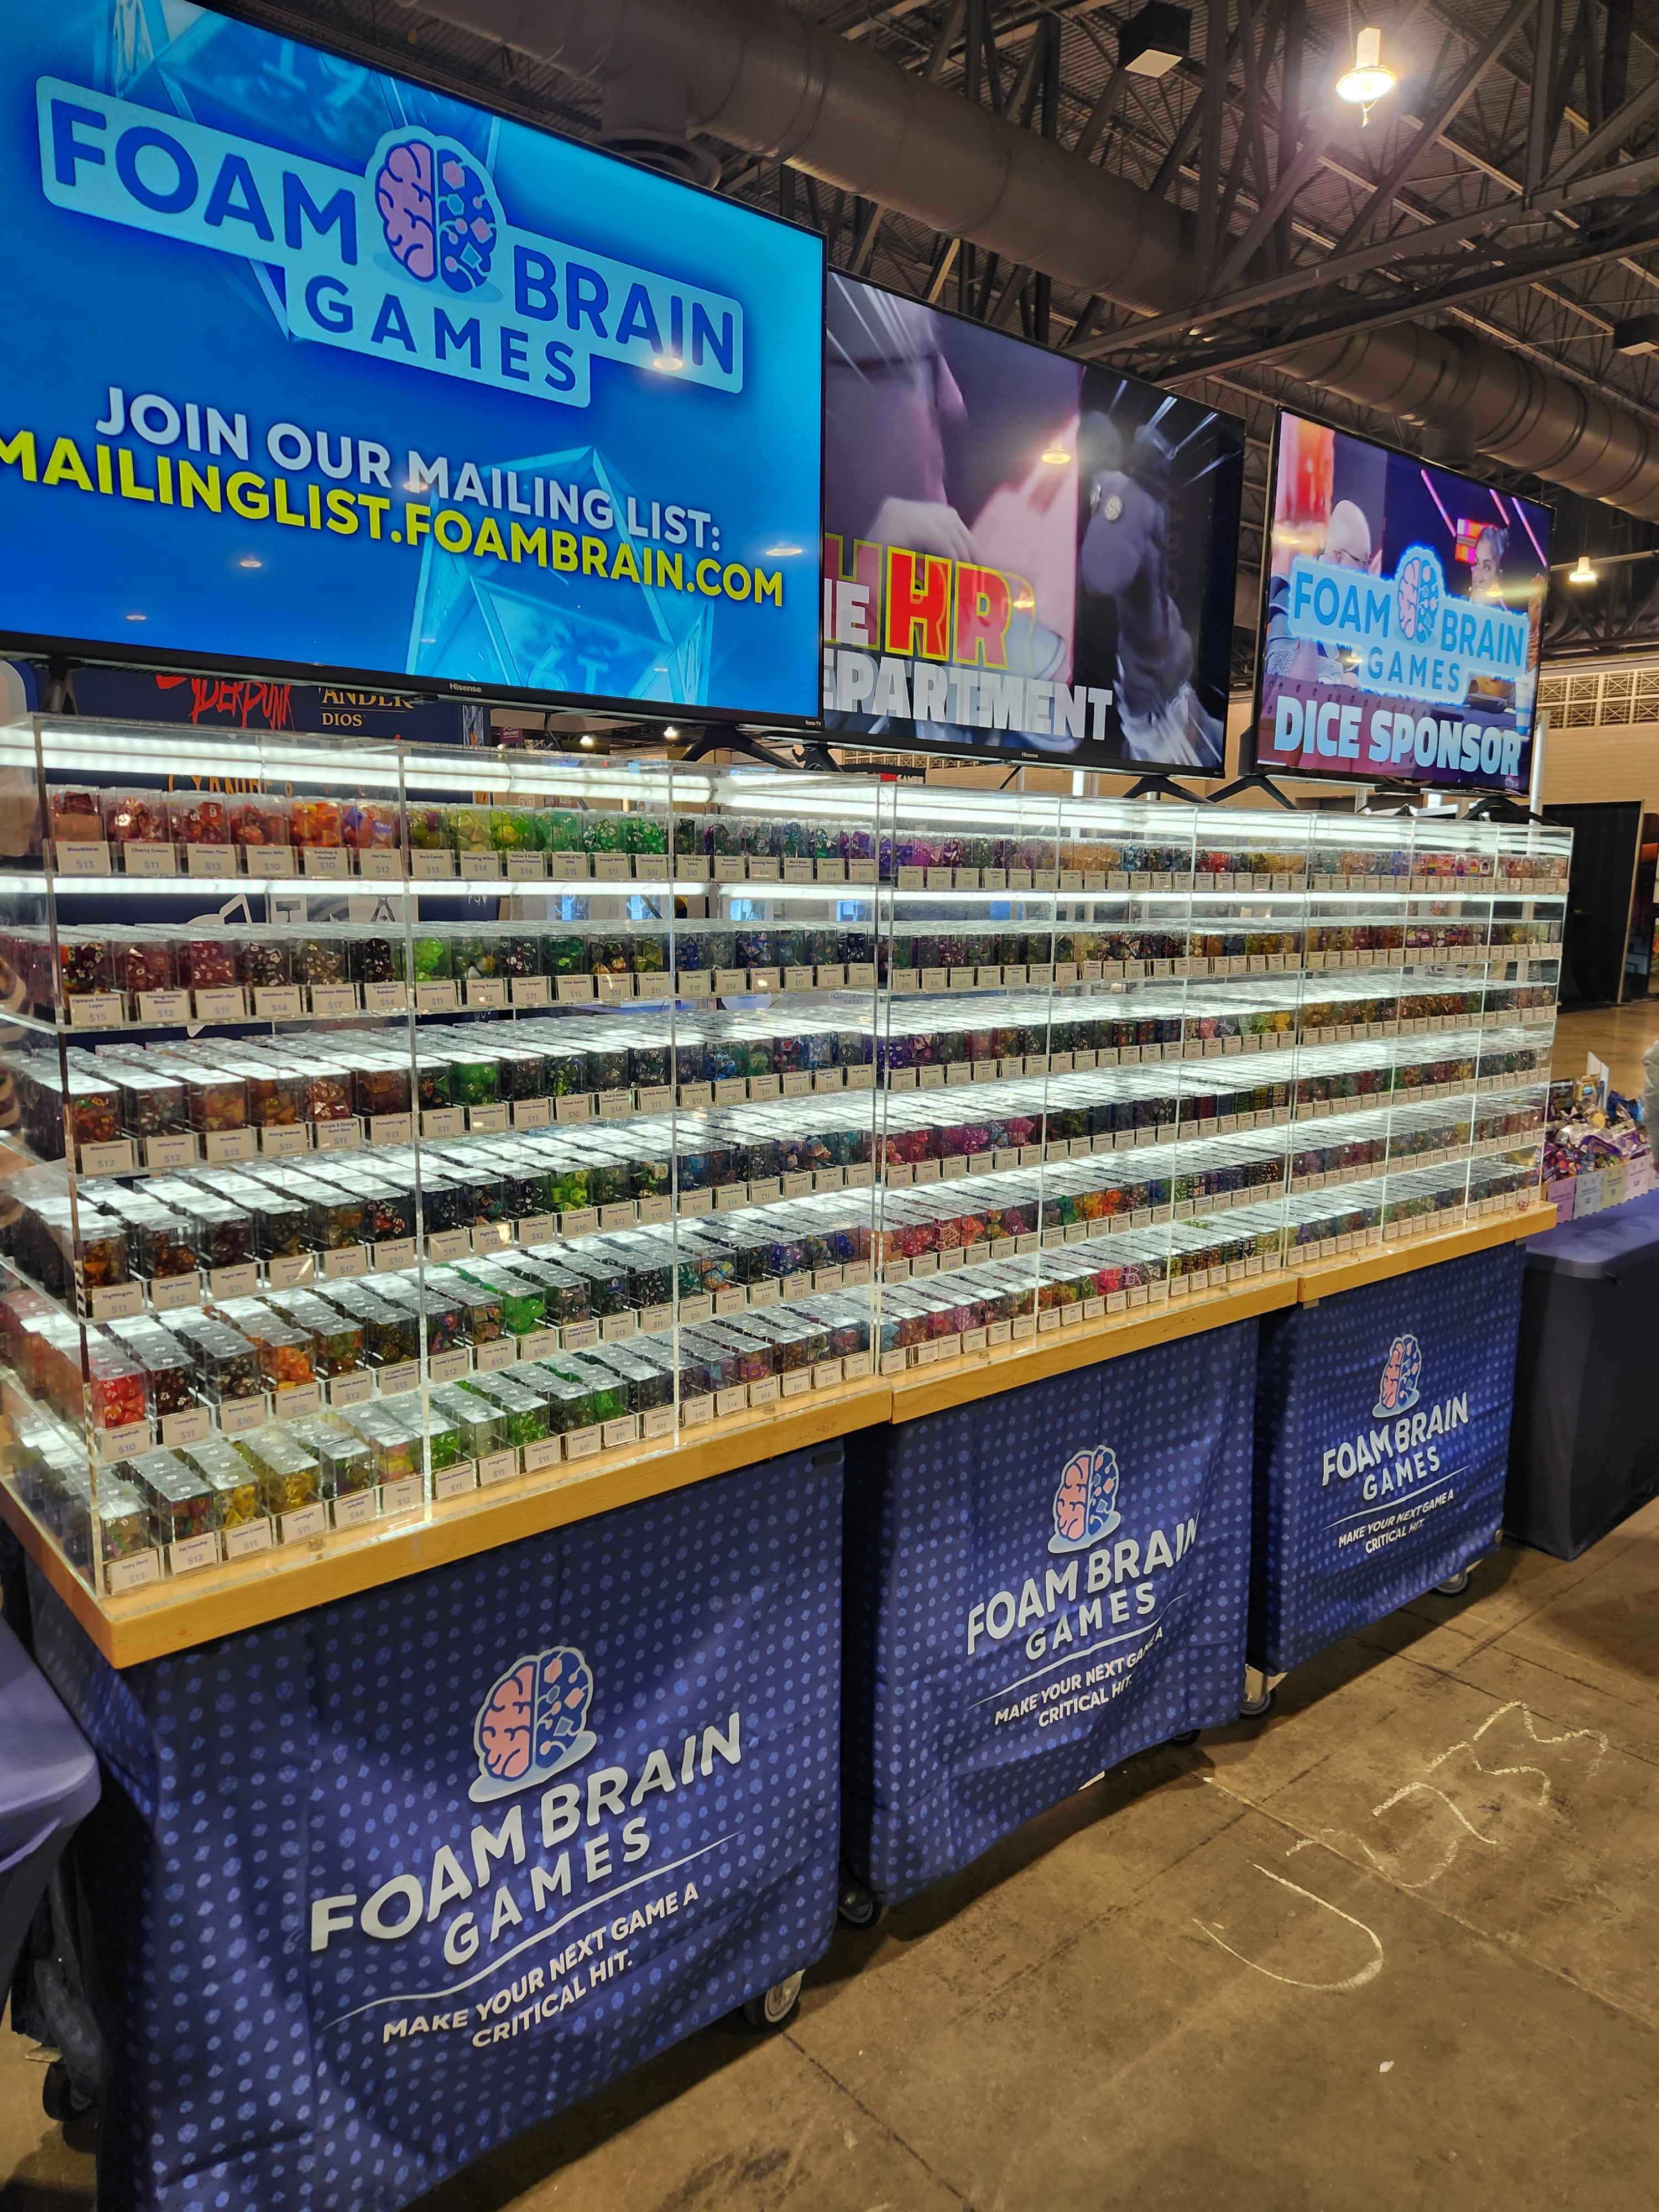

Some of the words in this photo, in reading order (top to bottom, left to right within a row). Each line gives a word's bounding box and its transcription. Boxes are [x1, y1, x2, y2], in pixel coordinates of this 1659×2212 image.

[52, 98, 358, 265] FOAM
[513, 244, 734, 376] BRAIN
[305, 275, 577, 393] GAMES
[96, 386, 248, 461] JOIN
[267, 422, 390, 486] OUR
[407, 456, 614, 531] MAILING
[626, 504, 721, 552] LIST:
[0, 429, 784, 607] MAILINGLIST.FOAMBRAIN.COM
[886, 546, 1011, 670] HR
[1294, 571, 1390, 638] FOAM
[1442, 609, 1524, 666] BRAIN
[449, 682, 482, 692] Hisense
[1368, 646, 1460, 693] GAMES
[322, 713, 362, 726] DIOS
[1274, 696, 1363, 760] DICE
[1369, 710, 1521, 776] SPONSOR
[1322, 1425, 1393, 1486] FOAM
[1396, 1392, 1468, 1453] BRAIN
[1363, 1446, 1440, 1500] GAMES
[1338, 1529, 1365, 1548] MAKE
[1367, 1516, 1394, 1536] YOUR
[1396, 1504, 1421, 1523] NEXT
[1422, 1495, 1447, 1512] GAME
[1447, 1489, 1454, 1501] A
[1365, 1530, 1407, 1553] CRITICAL
[967, 1561, 1078, 1655] FOAM
[1088, 1510, 1200, 1594] BRAIN
[1026, 1582, 1155, 1660] GAMES
[995, 1698, 1037, 1725] MAKE
[1041, 1674, 1082, 1704] YOUR
[1086, 1658, 1124, 1687] NEXT
[1155, 1626, 1163, 1642] A
[1039, 1695, 1109, 1727] CRITICAL
[311, 1804, 525, 1952] FOAM
[541, 1712, 742, 1848] BRAIN
[443, 1817, 650, 1965] GAMES
[383, 2009, 468, 2043] MAKE
[476, 1973, 545, 2020] YOUR
[550, 1928, 607, 1981] NEXT
[610, 1899, 677, 1942] GAME
[682, 1882, 698, 1908] A
[472, 1980, 587, 2048] CRITICAL
[590, 1949, 634, 1991] HIT.
